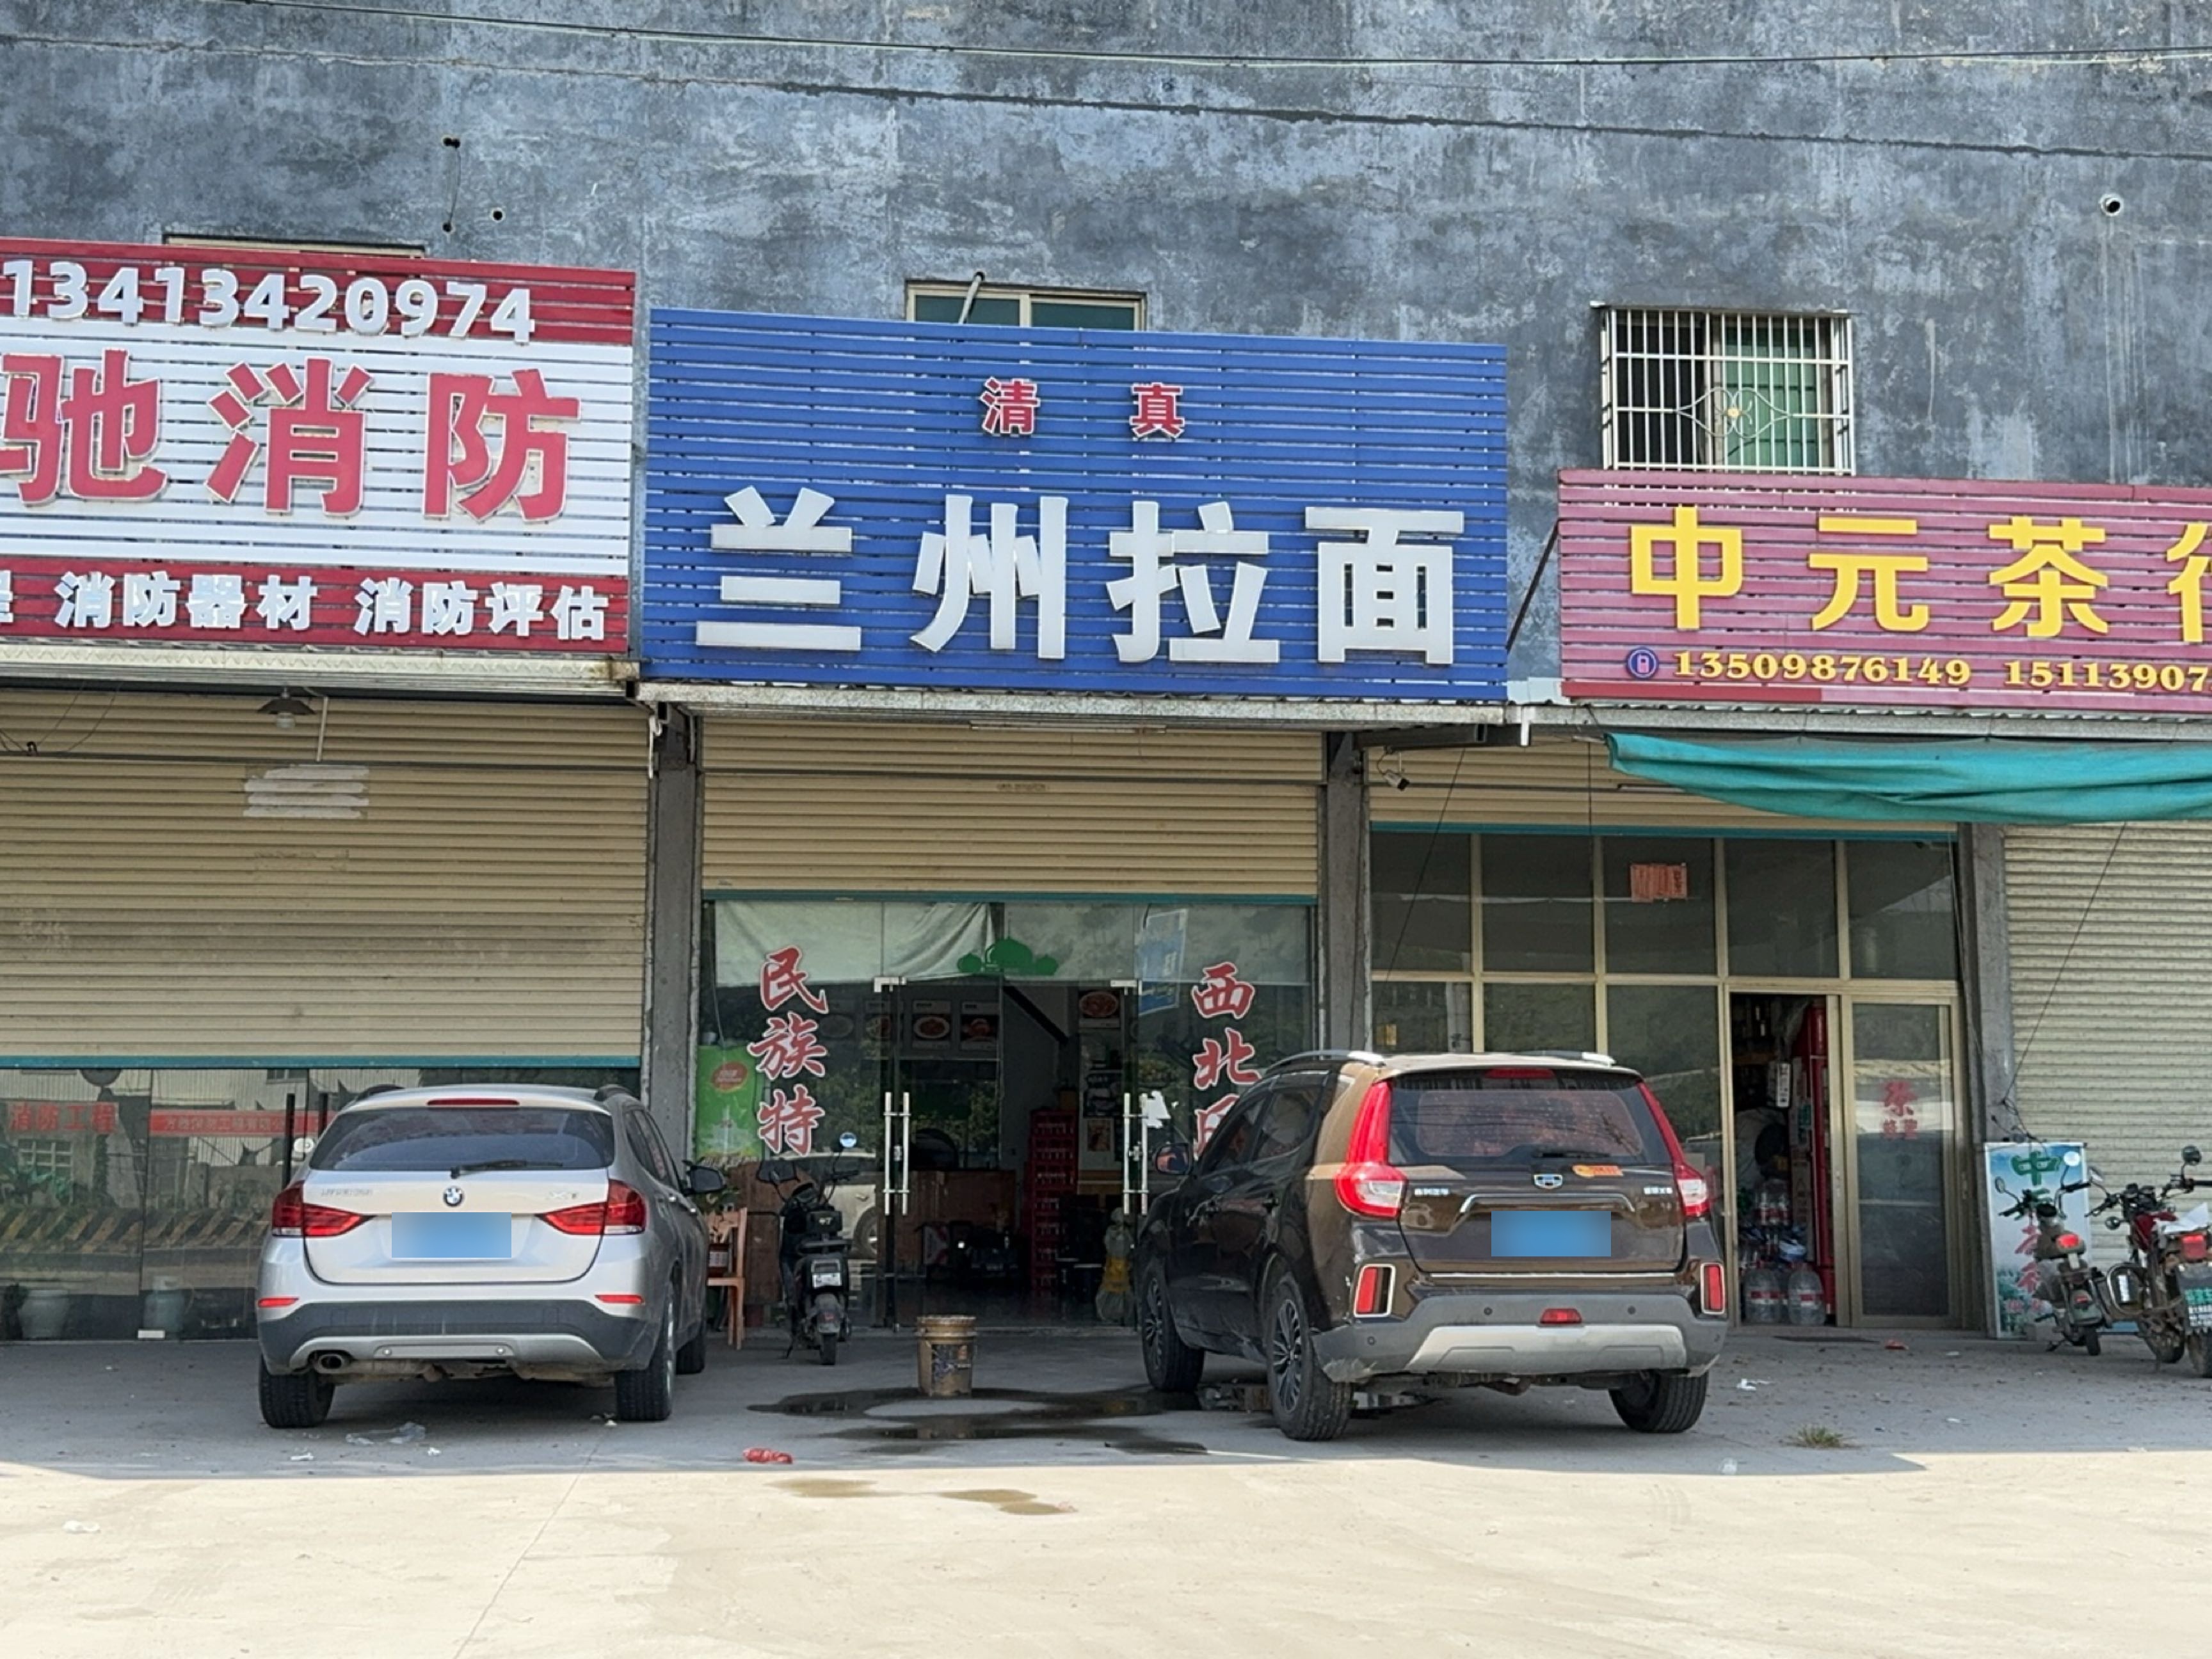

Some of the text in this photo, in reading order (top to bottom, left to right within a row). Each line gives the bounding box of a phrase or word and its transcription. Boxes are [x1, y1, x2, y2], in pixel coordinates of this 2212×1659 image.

[3, 259, 535, 346] 13413420974
[980, 376, 1185, 438] 清真
[55, 570, 316, 631] 消防器材
[353, 577, 608, 641] 消防评估
[695, 485, 1464, 666] 兰州拉面
[1673, 650, 2212, 693] 13509876149 15113907
[747, 945, 830, 1156] 民族特
